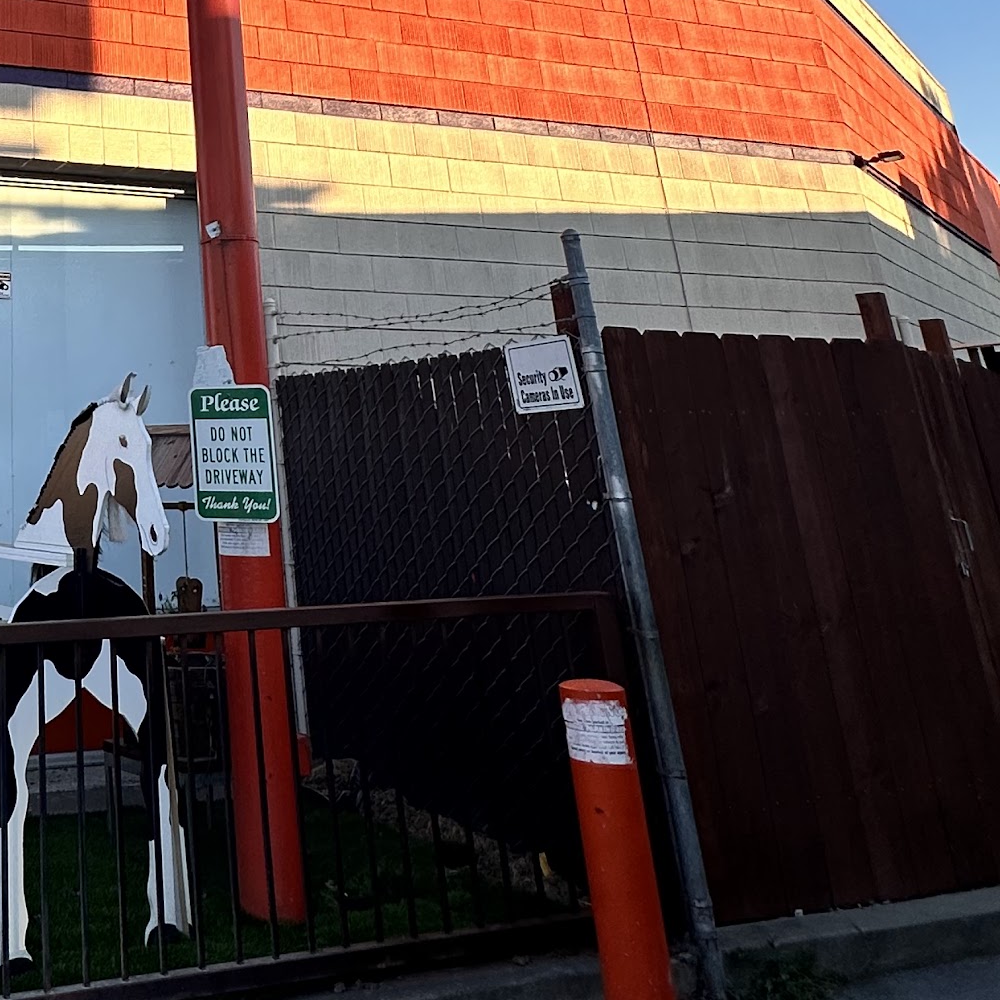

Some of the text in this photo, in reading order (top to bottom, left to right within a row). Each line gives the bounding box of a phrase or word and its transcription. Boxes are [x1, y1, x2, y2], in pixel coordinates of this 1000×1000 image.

[517, 369, 547, 386] Security
[200, 393, 260, 412] Please
[520, 385, 574, 403] Cameras In Use
[210, 426, 253, 442] DO NOT
[202, 447, 266, 463] BLOCK THE
[205, 469, 264, 485] DRIVEWAY
[201, 496, 271, 513] Thank You!
